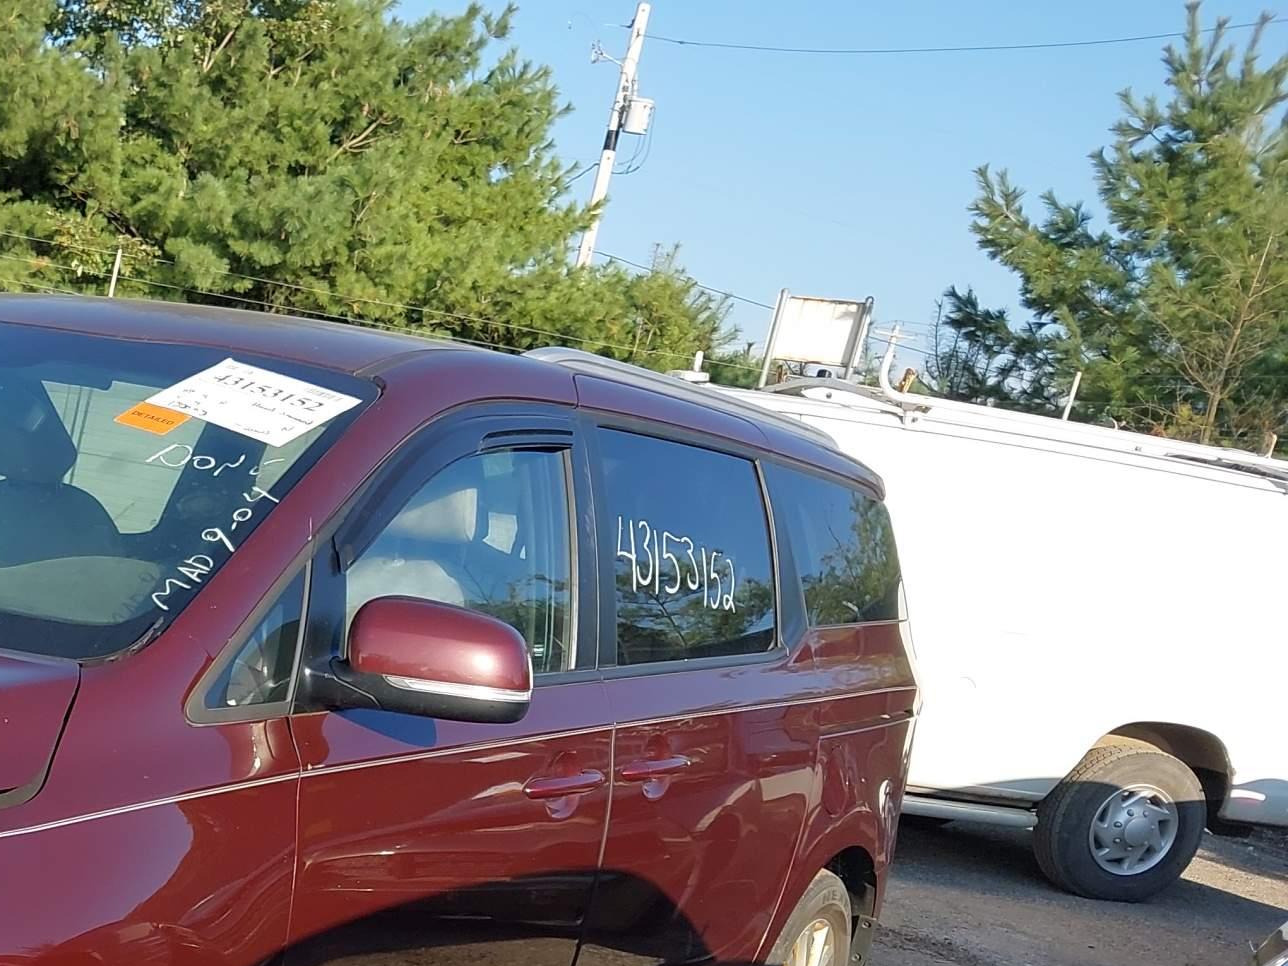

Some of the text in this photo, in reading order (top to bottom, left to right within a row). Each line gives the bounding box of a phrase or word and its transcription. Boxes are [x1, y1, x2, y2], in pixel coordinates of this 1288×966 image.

[214, 374, 324, 412] 43153152
[151, 554, 214, 611] MAD
[616, 515, 736, 614] 43153152
